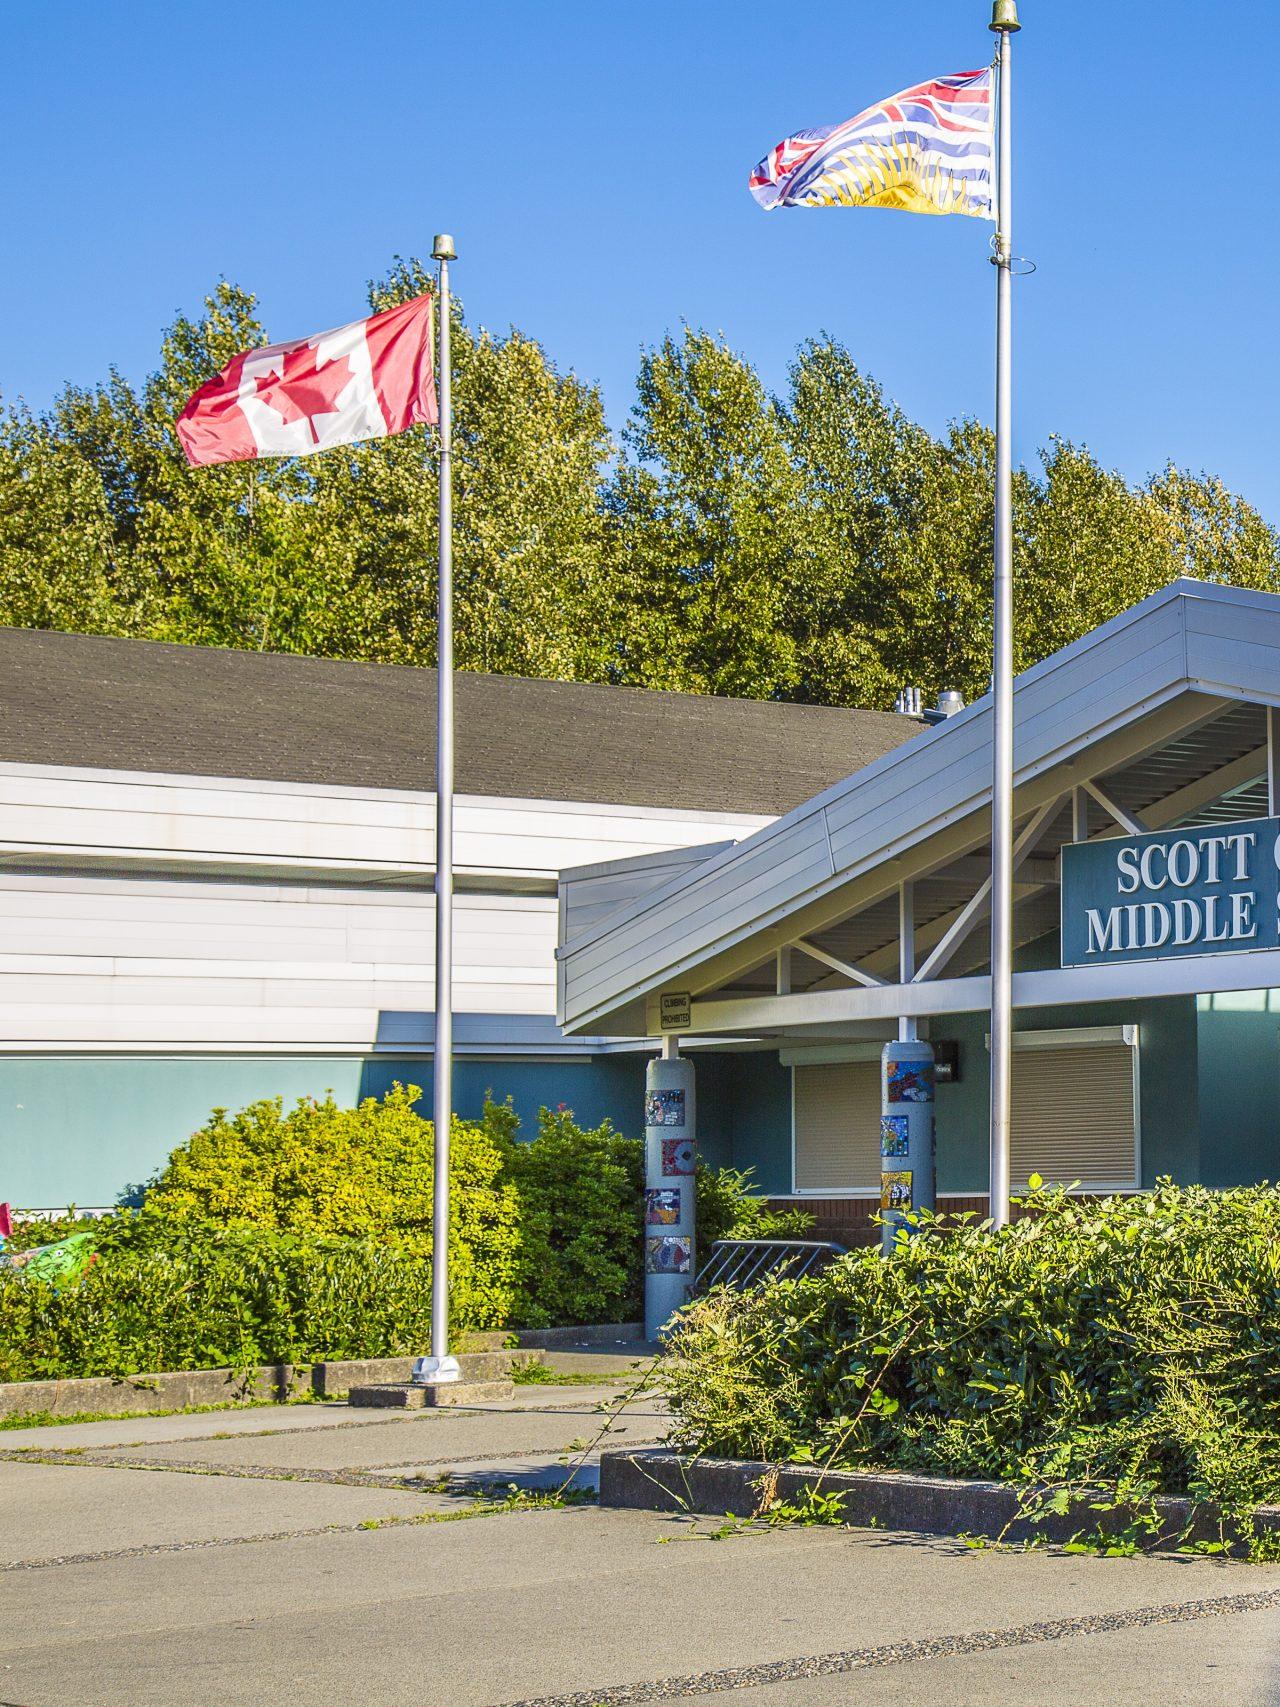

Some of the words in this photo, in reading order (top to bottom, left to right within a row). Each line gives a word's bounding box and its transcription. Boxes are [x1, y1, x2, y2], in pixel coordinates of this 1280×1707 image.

[1117, 832, 1257, 893] SCOTT
[1085, 891, 1257, 954] MIDDLE
[662, 1013, 689, 1024] PROHIBITED
[664, 997, 687, 1008] CLIMBING
